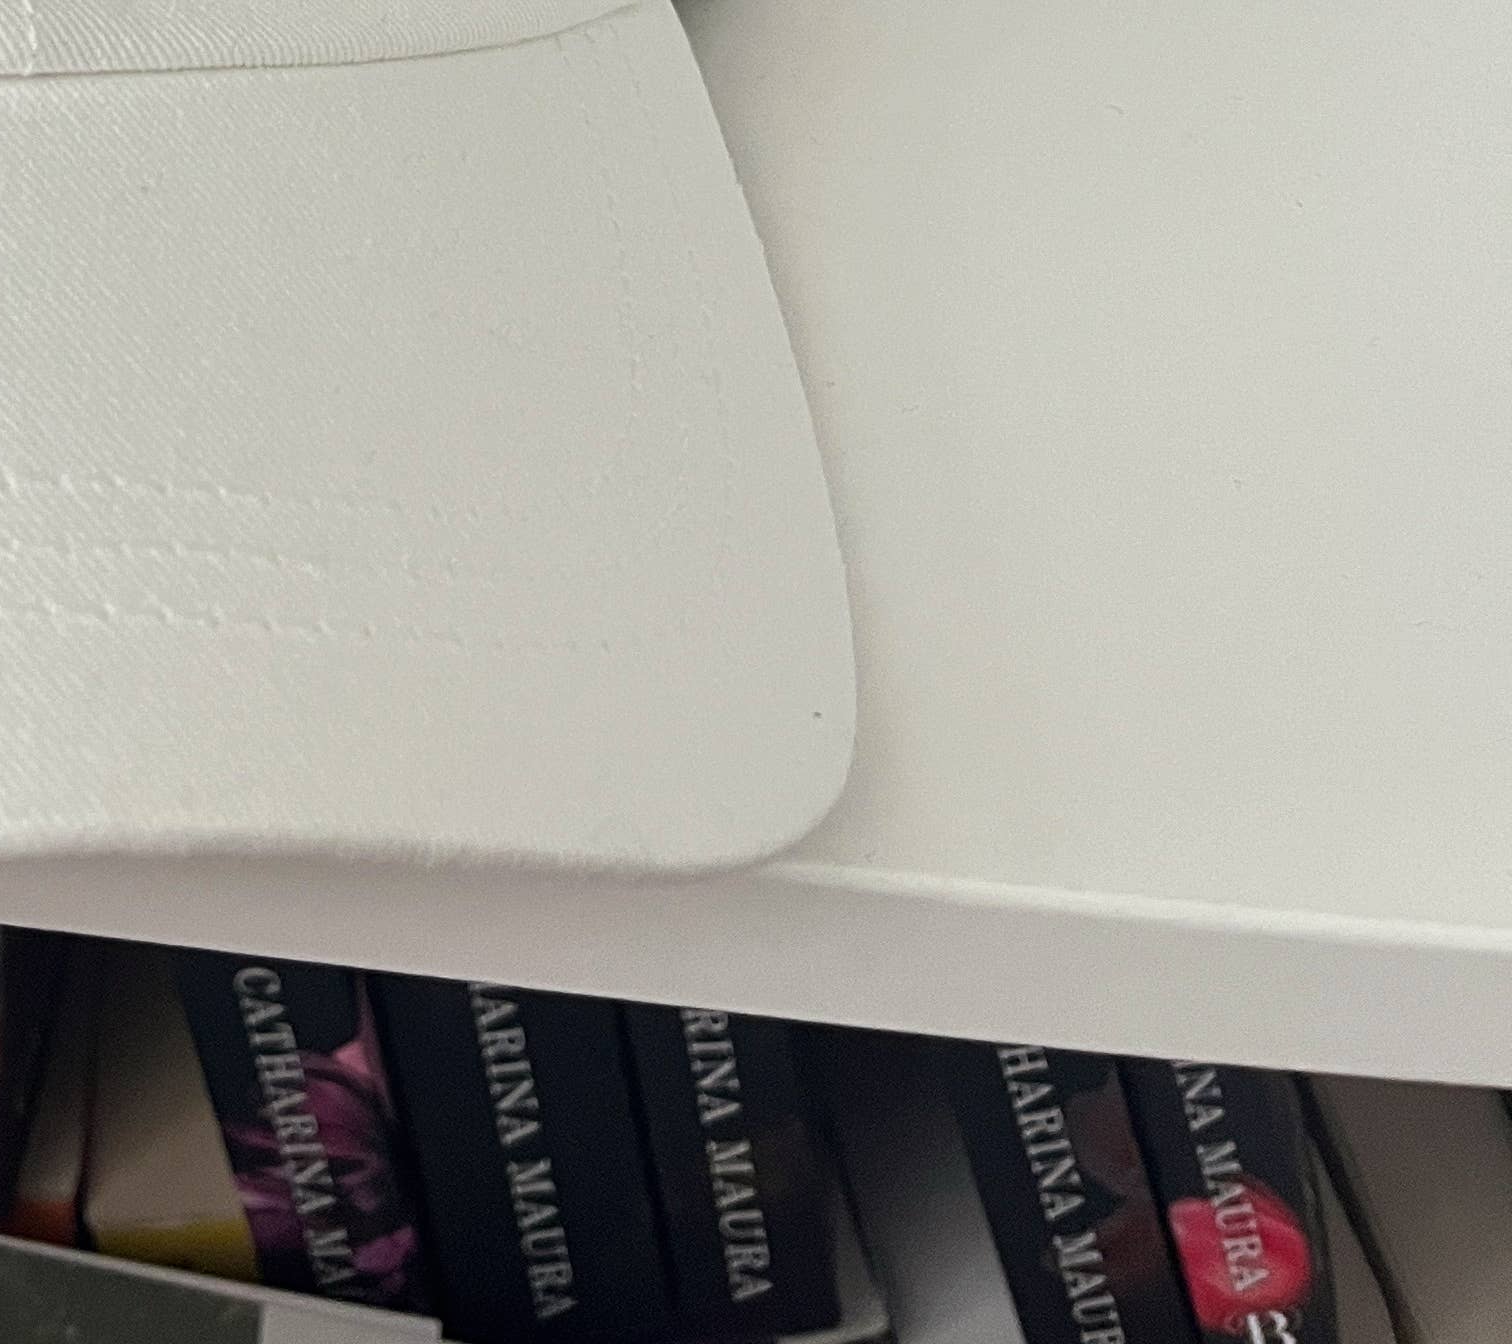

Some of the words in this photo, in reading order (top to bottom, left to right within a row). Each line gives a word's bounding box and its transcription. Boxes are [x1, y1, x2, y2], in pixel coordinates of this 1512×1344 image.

[233, 965, 338, 1216] CATHARINA
[506, 1158, 577, 1320] MAURA
[705, 1139, 774, 1304] MAURA
[1196, 1141, 1271, 1294] MAURA
